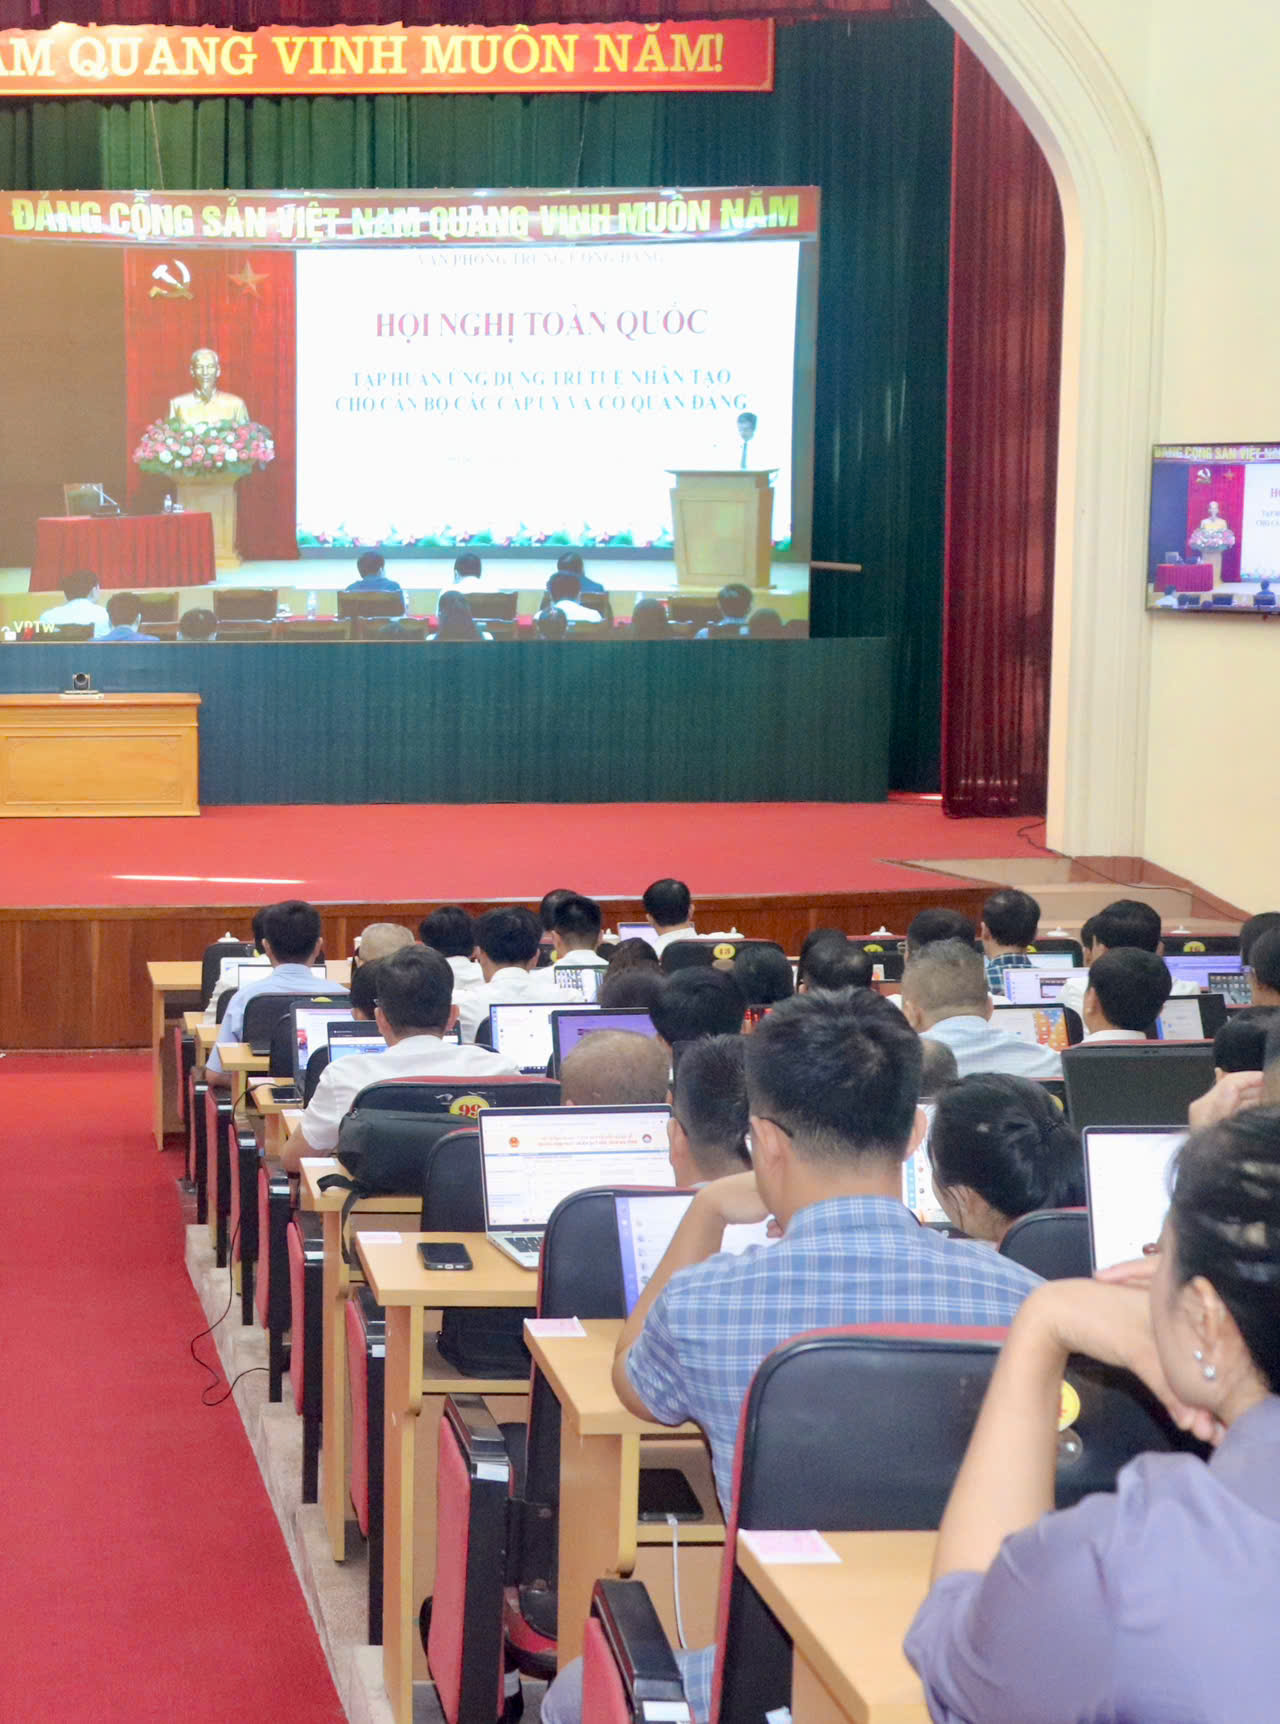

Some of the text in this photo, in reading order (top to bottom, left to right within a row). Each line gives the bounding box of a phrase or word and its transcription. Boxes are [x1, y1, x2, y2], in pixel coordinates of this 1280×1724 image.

[69, 36, 258, 79] QUANG
[272, 36, 408, 75] VINH
[421, 24, 579, 74] MUÔN
[594, 22, 724, 73] NĂM!
[352, 205, 420, 239] NAM
[429, 205, 528, 240] QUANG
[618, 194, 711, 233] MUÔN
[721, 190, 799, 228] NĂM
